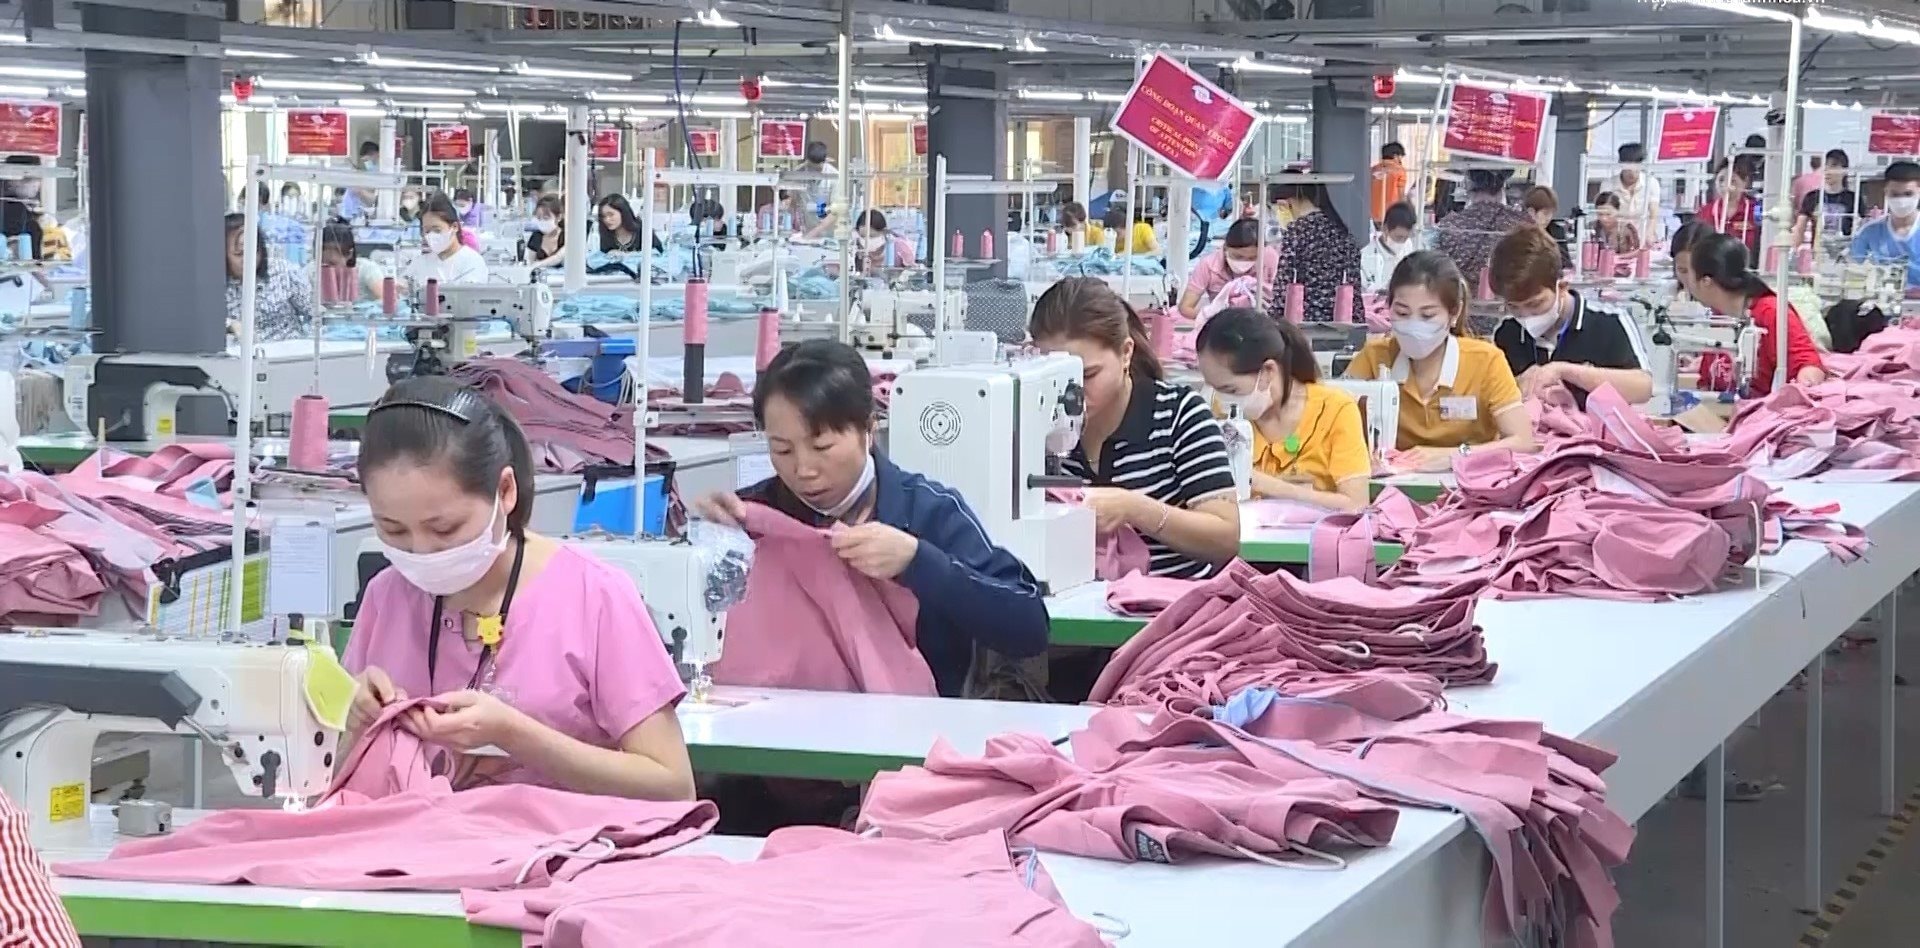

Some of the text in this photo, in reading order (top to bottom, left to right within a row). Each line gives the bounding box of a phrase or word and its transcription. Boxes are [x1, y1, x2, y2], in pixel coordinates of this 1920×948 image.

[1152, 117, 1181, 138] CRITICAL
[1150, 125, 1196, 157] OF ATTENTION
